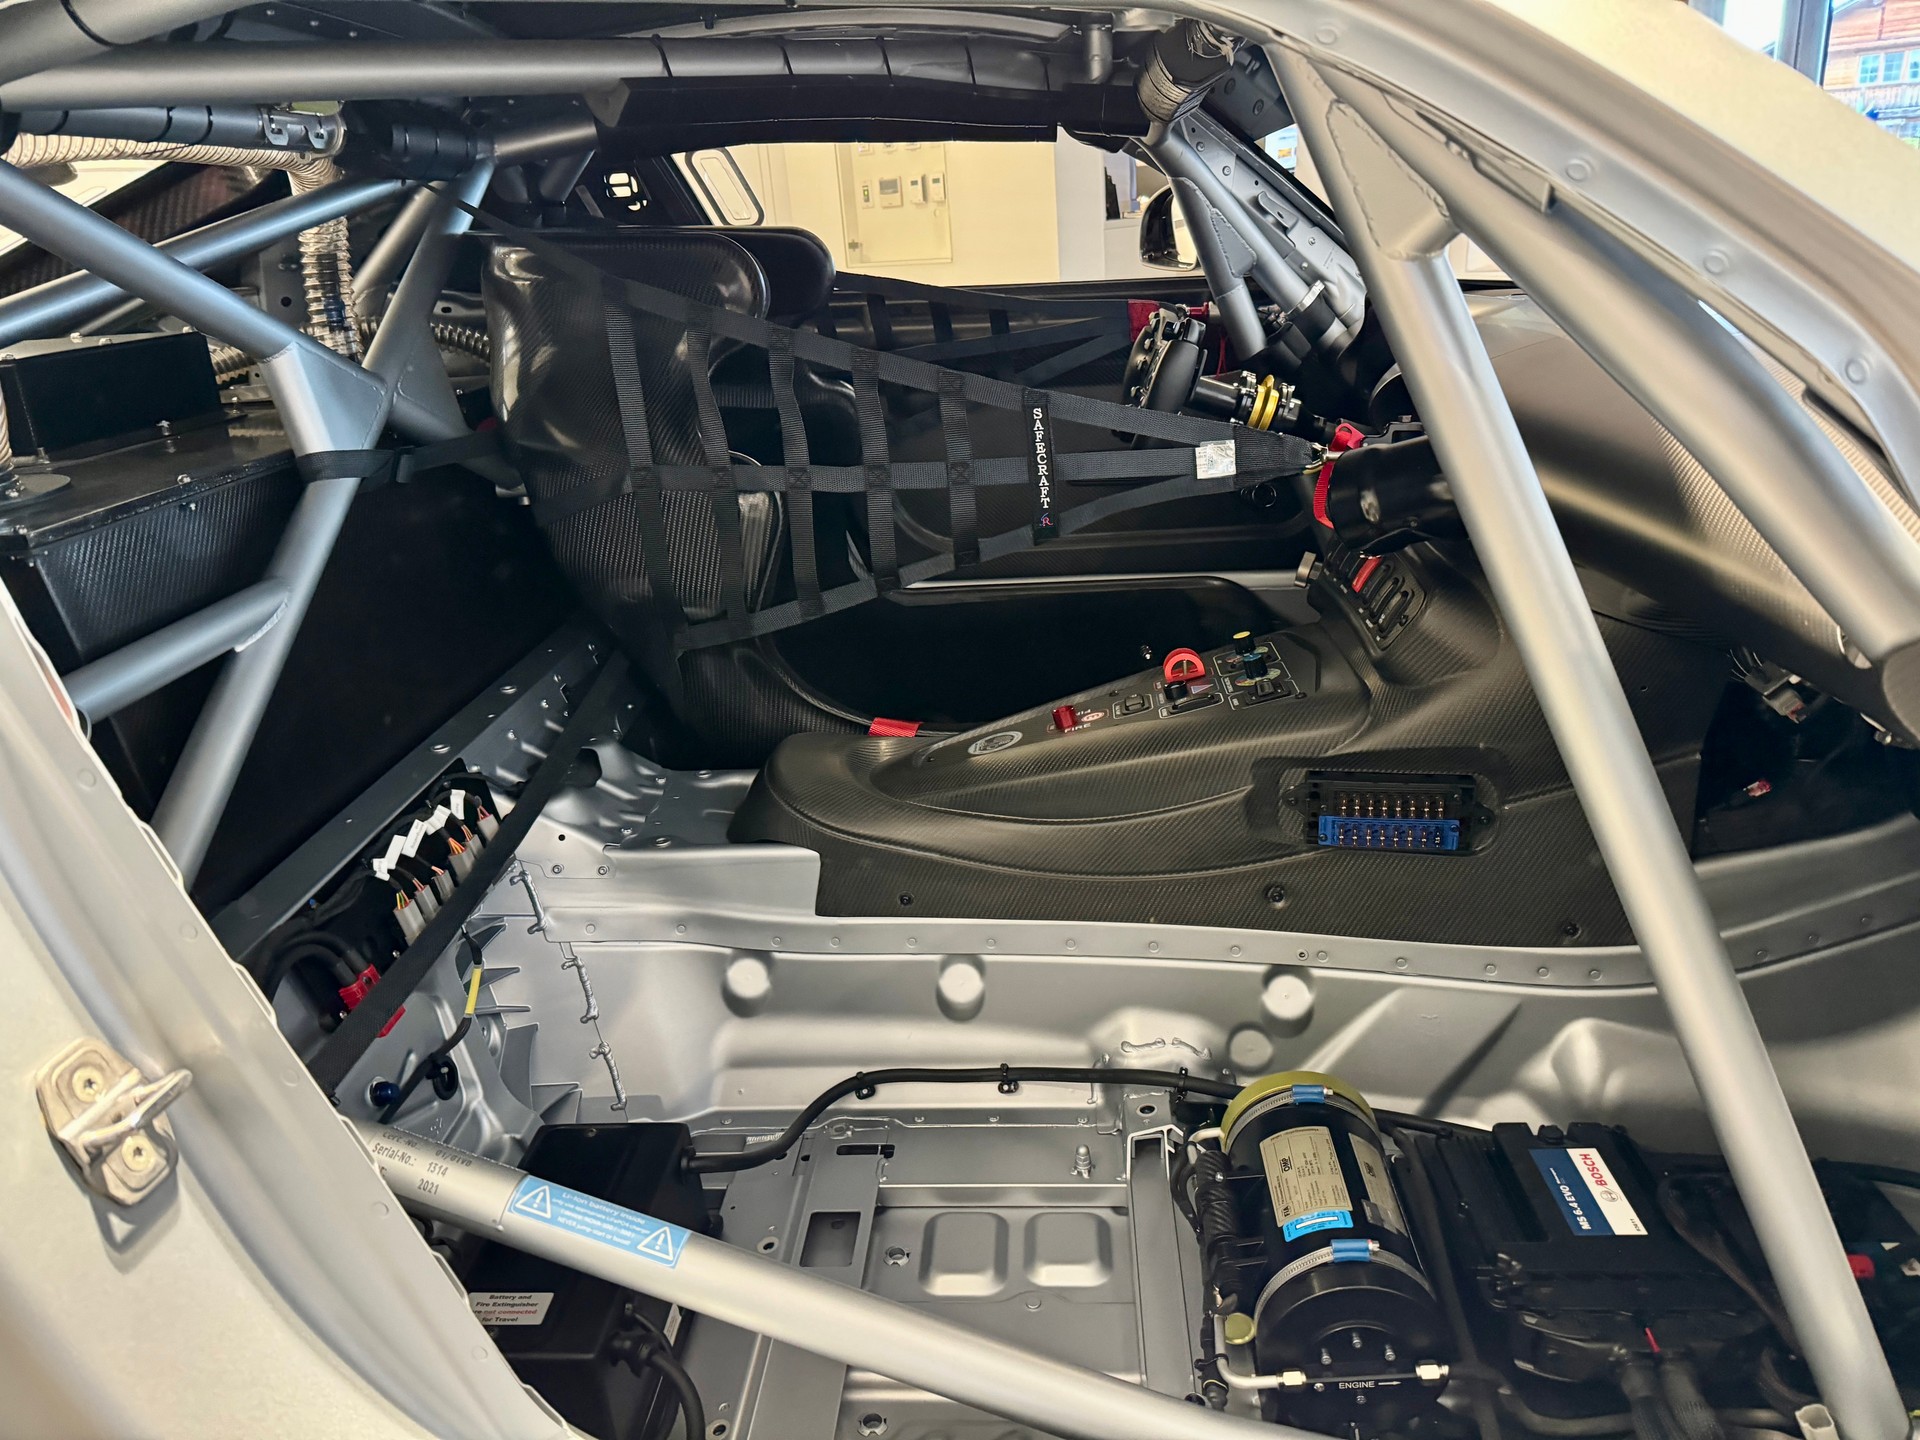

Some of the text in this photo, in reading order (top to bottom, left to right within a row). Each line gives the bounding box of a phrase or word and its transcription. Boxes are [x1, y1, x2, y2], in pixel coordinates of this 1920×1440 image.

[1033, 408, 1050, 508] SAFECRAFT
[426, 1161, 449, 1177] 1314
[1281, 1157, 1292, 1172] OMP
[1579, 1153, 1608, 1186] BOSCH
[417, 1178, 440, 1195] 2021
[1560, 1185, 1576, 1202] EVO
[588, 1201, 620, 1217] battery
[620, 1212, 646, 1224] inside
[1283, 1206, 1291, 1217] FIA
[1569, 1202, 1583, 1216] 6.4
[557, 1216, 577, 1227] NEVER
[1577, 1216, 1592, 1230] MS
[1338, 1381, 1376, 1390] ENGINE
